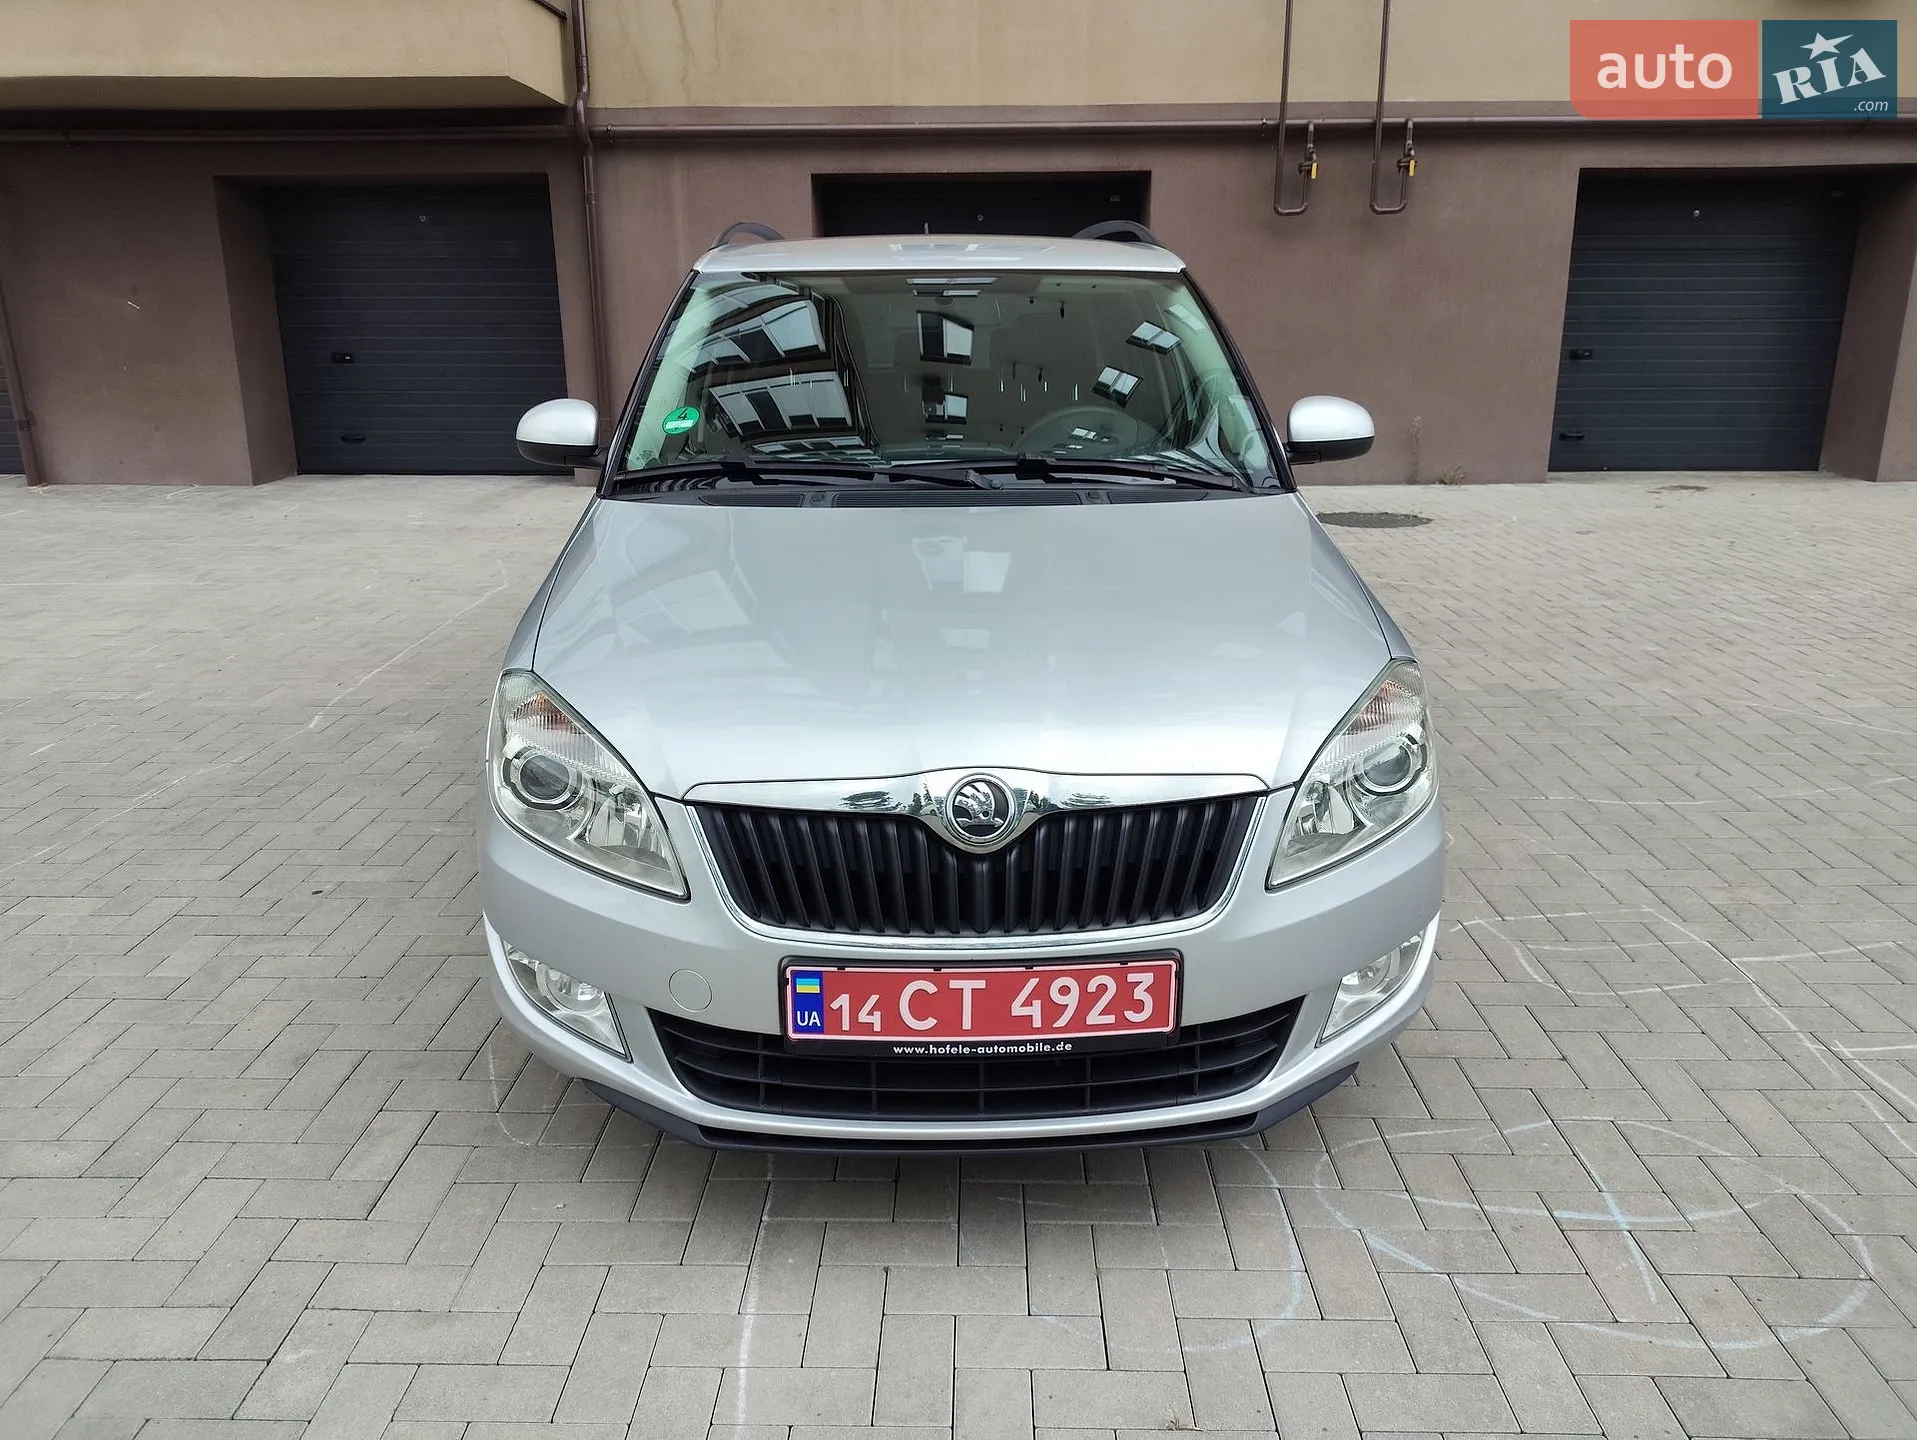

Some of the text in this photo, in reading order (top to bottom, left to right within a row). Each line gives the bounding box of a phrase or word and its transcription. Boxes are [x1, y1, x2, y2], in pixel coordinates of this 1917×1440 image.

[676, 407, 688, 420] 4
[829, 972, 1154, 1032] 14 CT 4923
[796, 1010, 822, 1027] UA
[893, 1041, 1073, 1055] www.hofele-automobile.de
